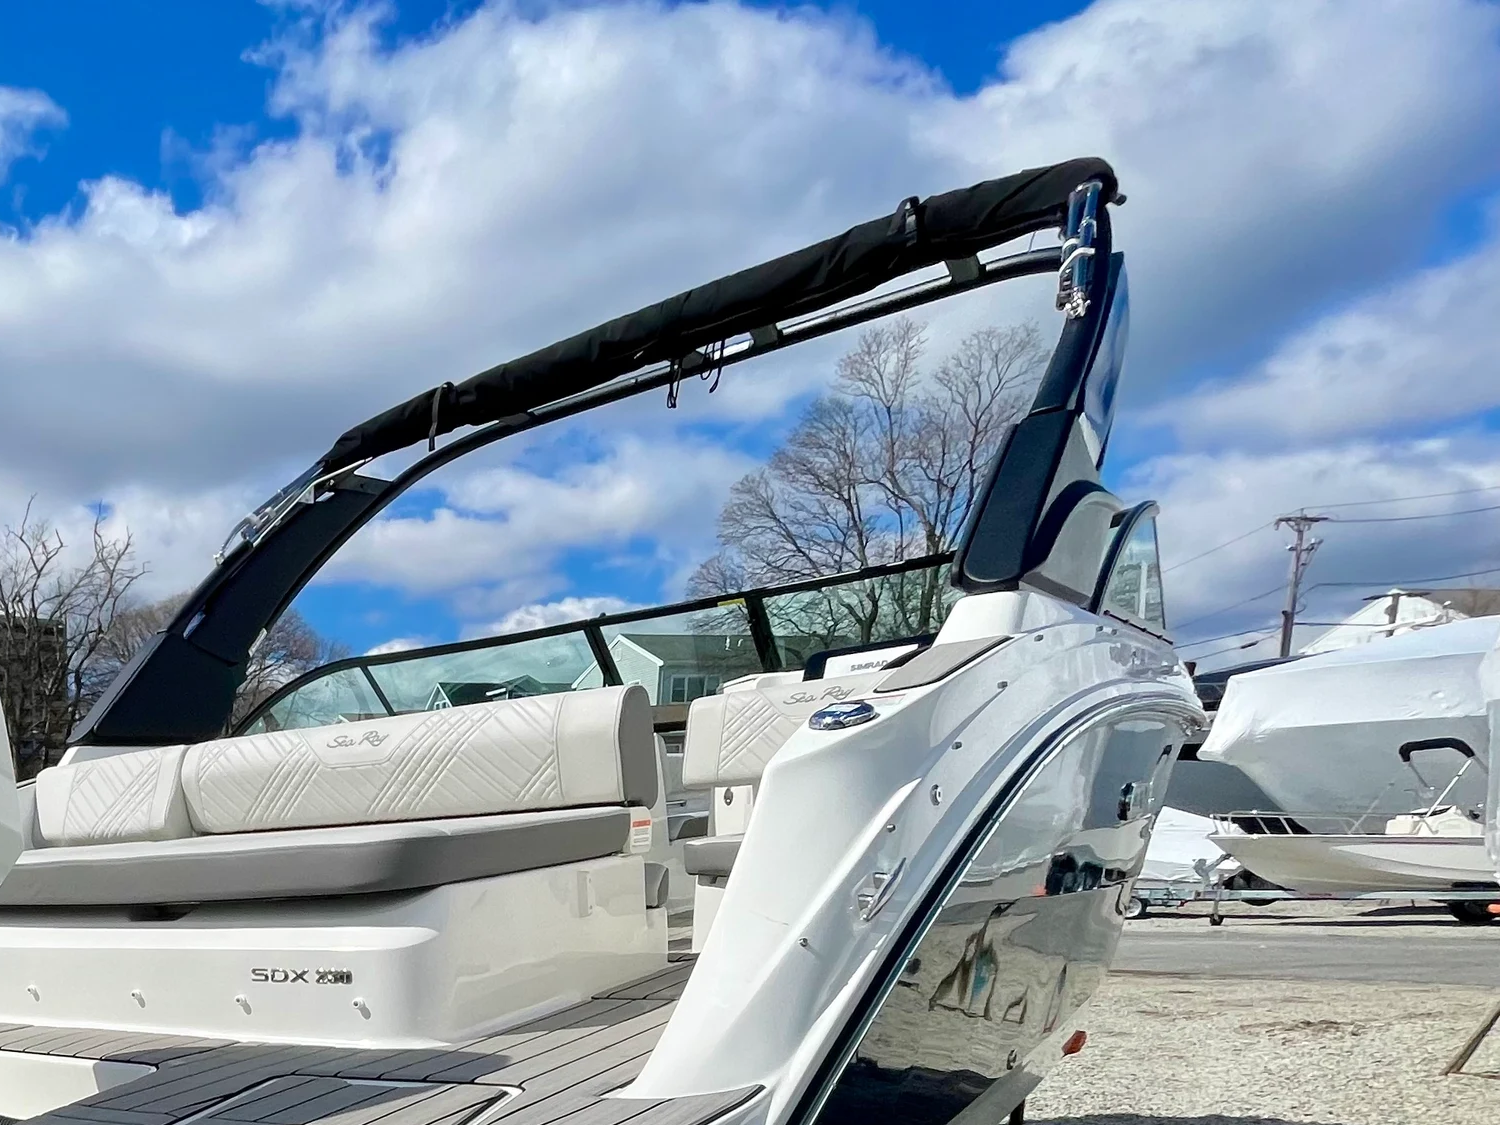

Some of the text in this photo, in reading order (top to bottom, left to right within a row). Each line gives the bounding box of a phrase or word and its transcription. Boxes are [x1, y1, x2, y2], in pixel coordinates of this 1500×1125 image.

[783, 685, 856, 705] Sea Ray
[326, 730, 390, 749] Sea Ray
[250, 967, 309, 984] SDX
